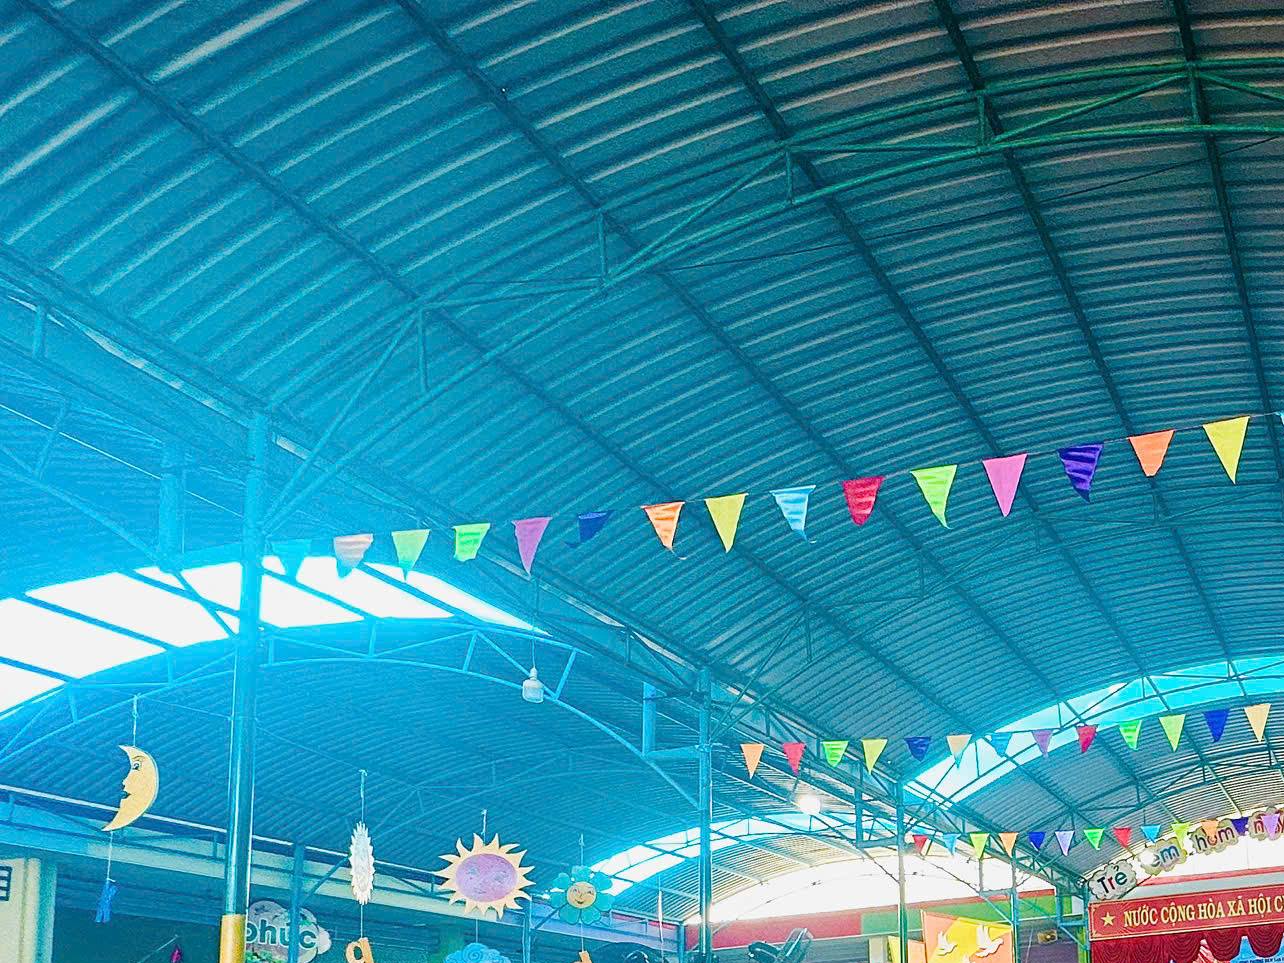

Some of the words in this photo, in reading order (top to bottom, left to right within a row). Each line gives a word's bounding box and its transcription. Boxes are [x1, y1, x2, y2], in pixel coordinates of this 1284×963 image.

[1097, 864, 1128, 894] Trẻ
[1124, 904, 1157, 927] NƯỚC
[1160, 902, 1195, 926] CỘNG
[1198, 898, 1225, 920] HÒA
[1228, 895, 1244, 916] XÃ
[1249, 893, 1272, 918] HỘI
